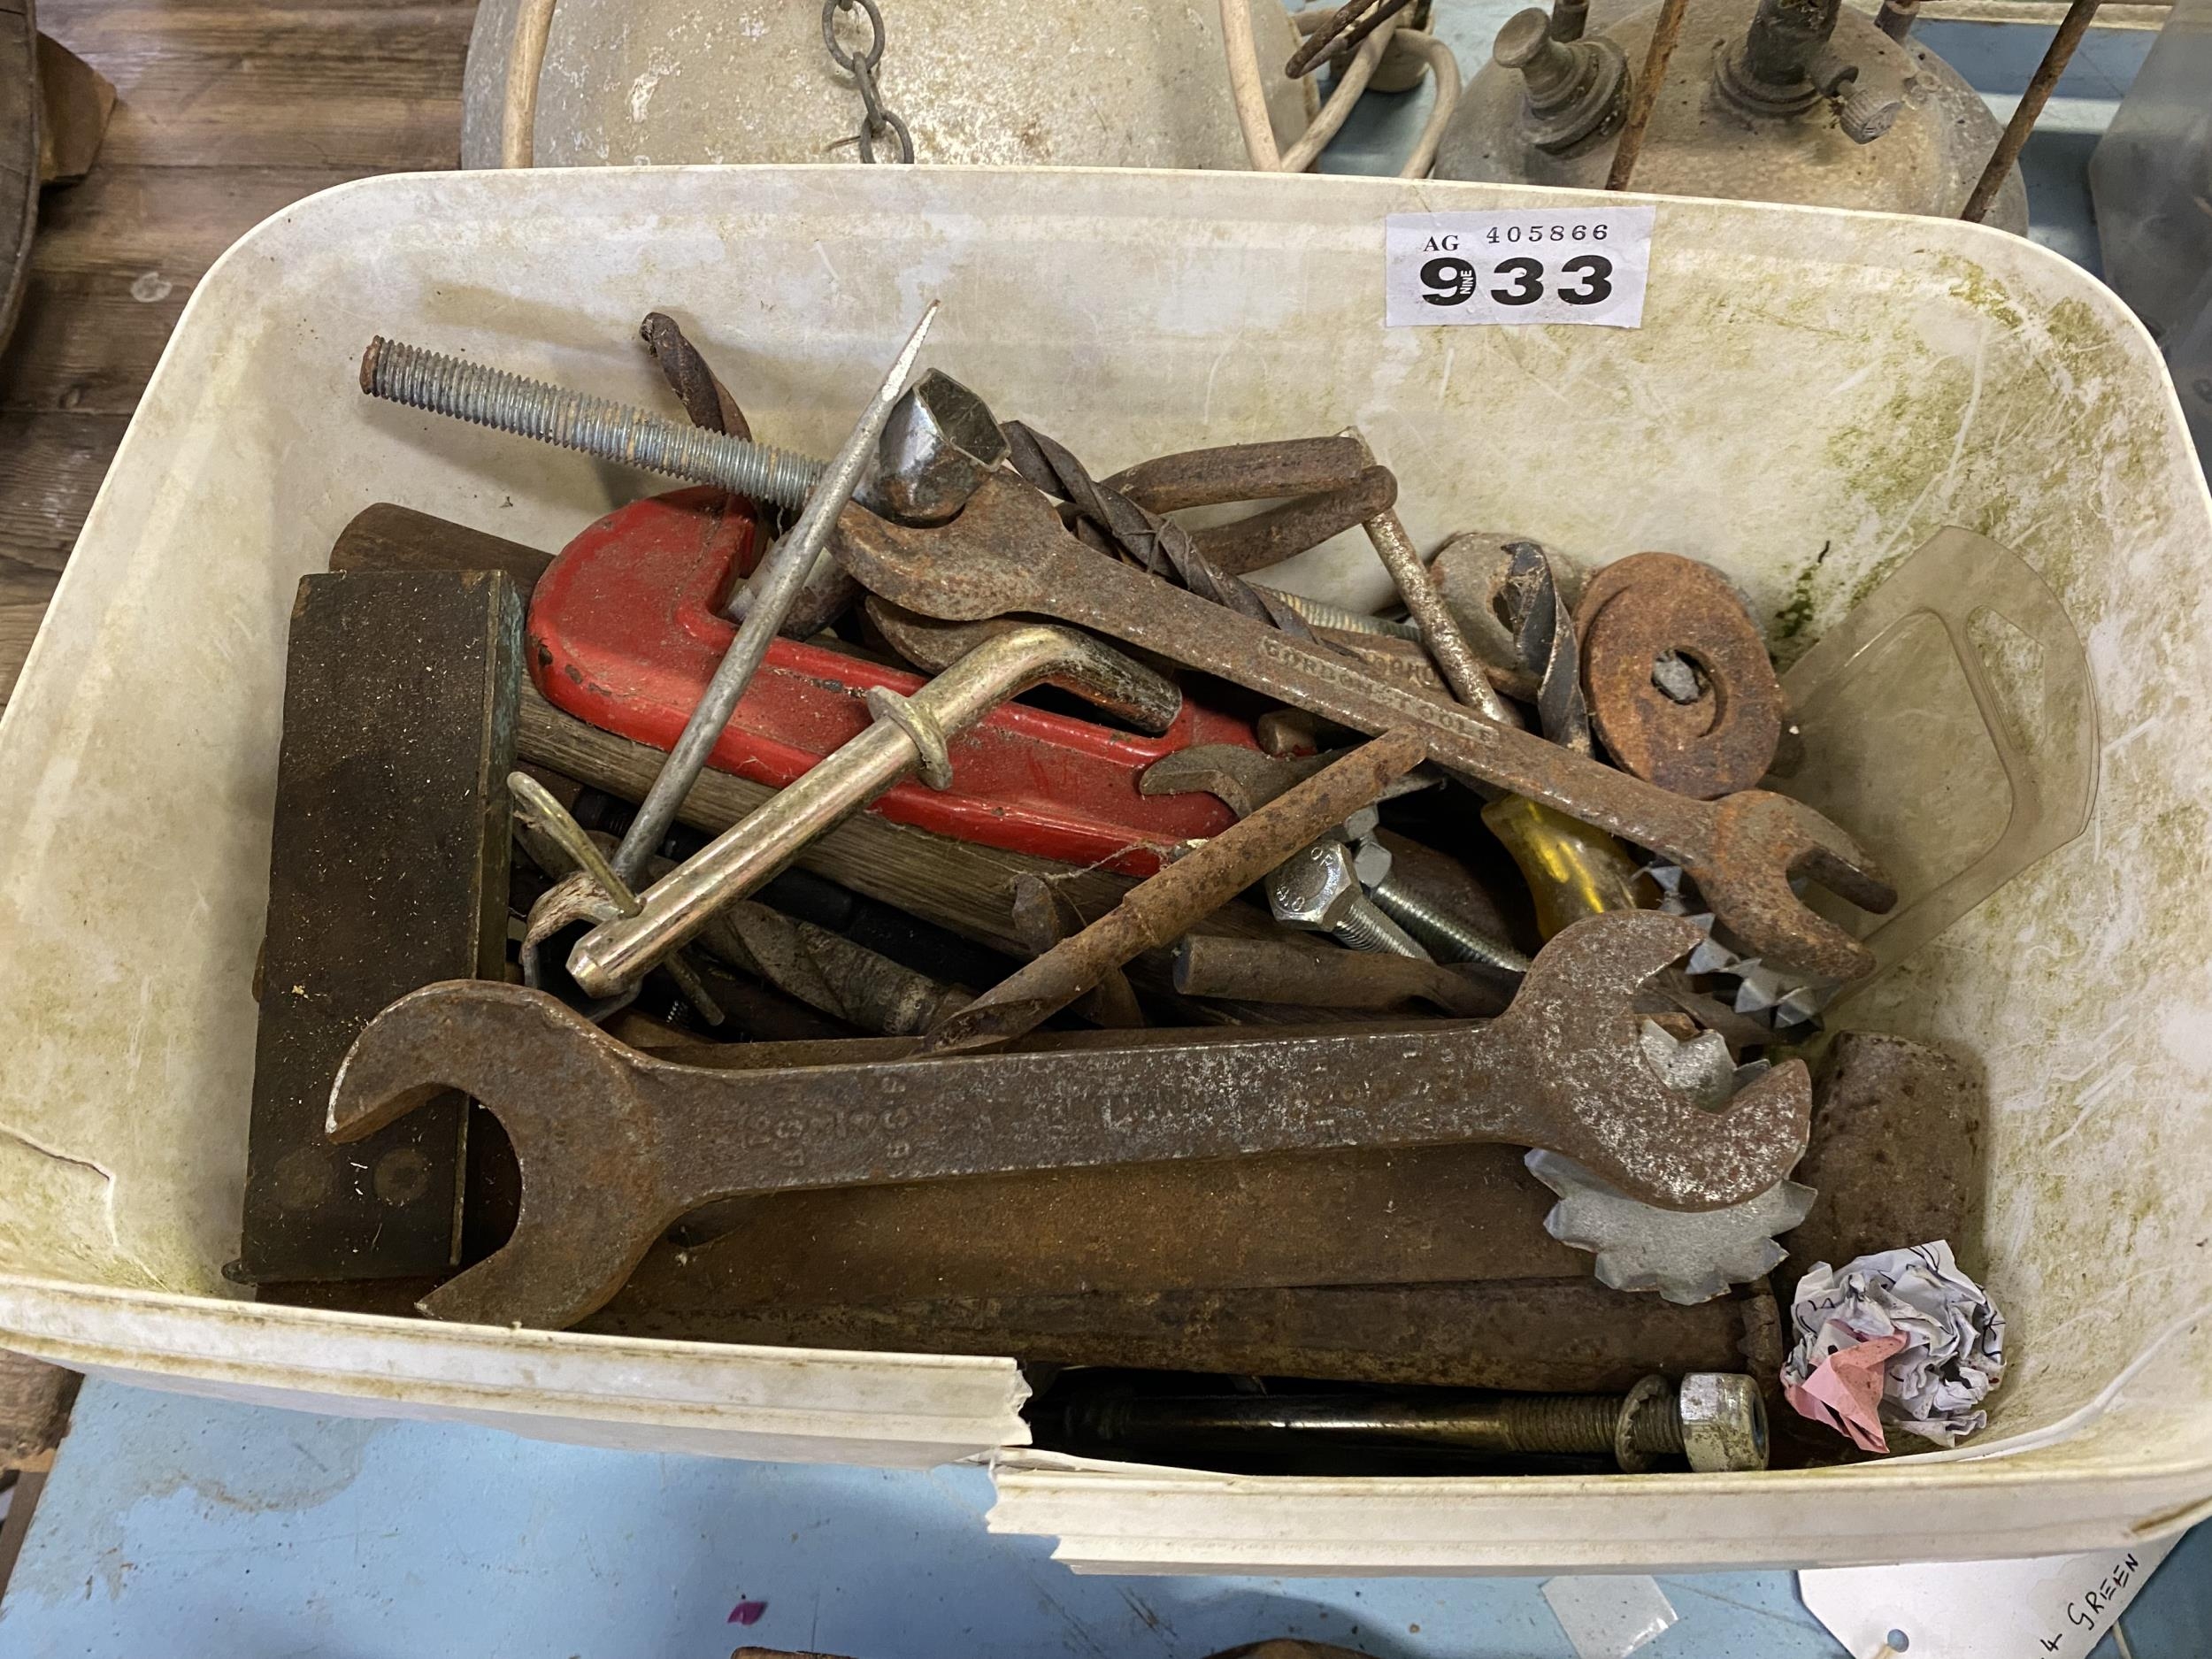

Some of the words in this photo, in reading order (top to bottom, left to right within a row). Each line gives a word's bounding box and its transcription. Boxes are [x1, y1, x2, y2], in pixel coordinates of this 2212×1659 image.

[1423, 235, 1459, 252] AG
[1486, 224, 1609, 244] 405866
[1420, 254, 1613, 306] 933
[1460, 269, 1472, 295] NINE
[2067, 1553, 2139, 1631] GREEN
